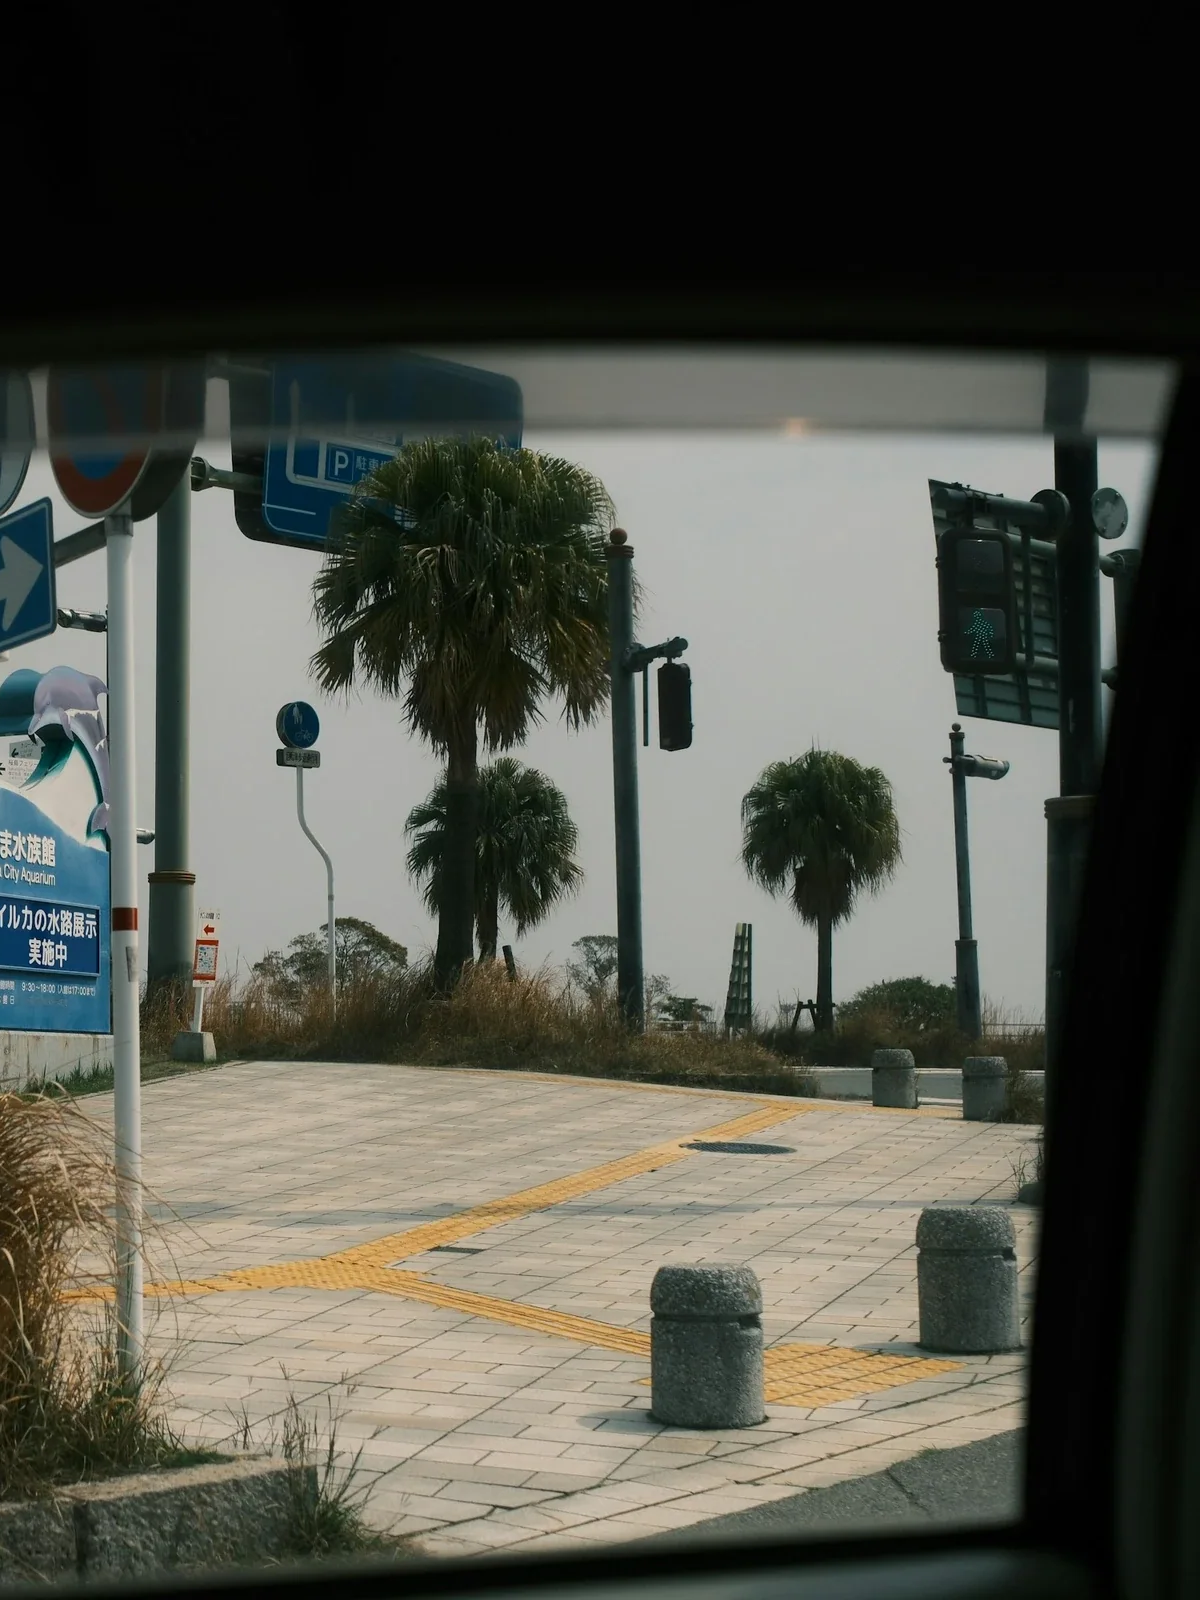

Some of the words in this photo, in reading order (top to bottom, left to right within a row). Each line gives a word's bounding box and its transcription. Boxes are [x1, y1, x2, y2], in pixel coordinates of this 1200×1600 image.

[334, 450, 349, 476] P
[3, 864, 19, 883] City
[21, 866, 56, 886] Aquarium
[28, 938, 68, 968] 実施中
